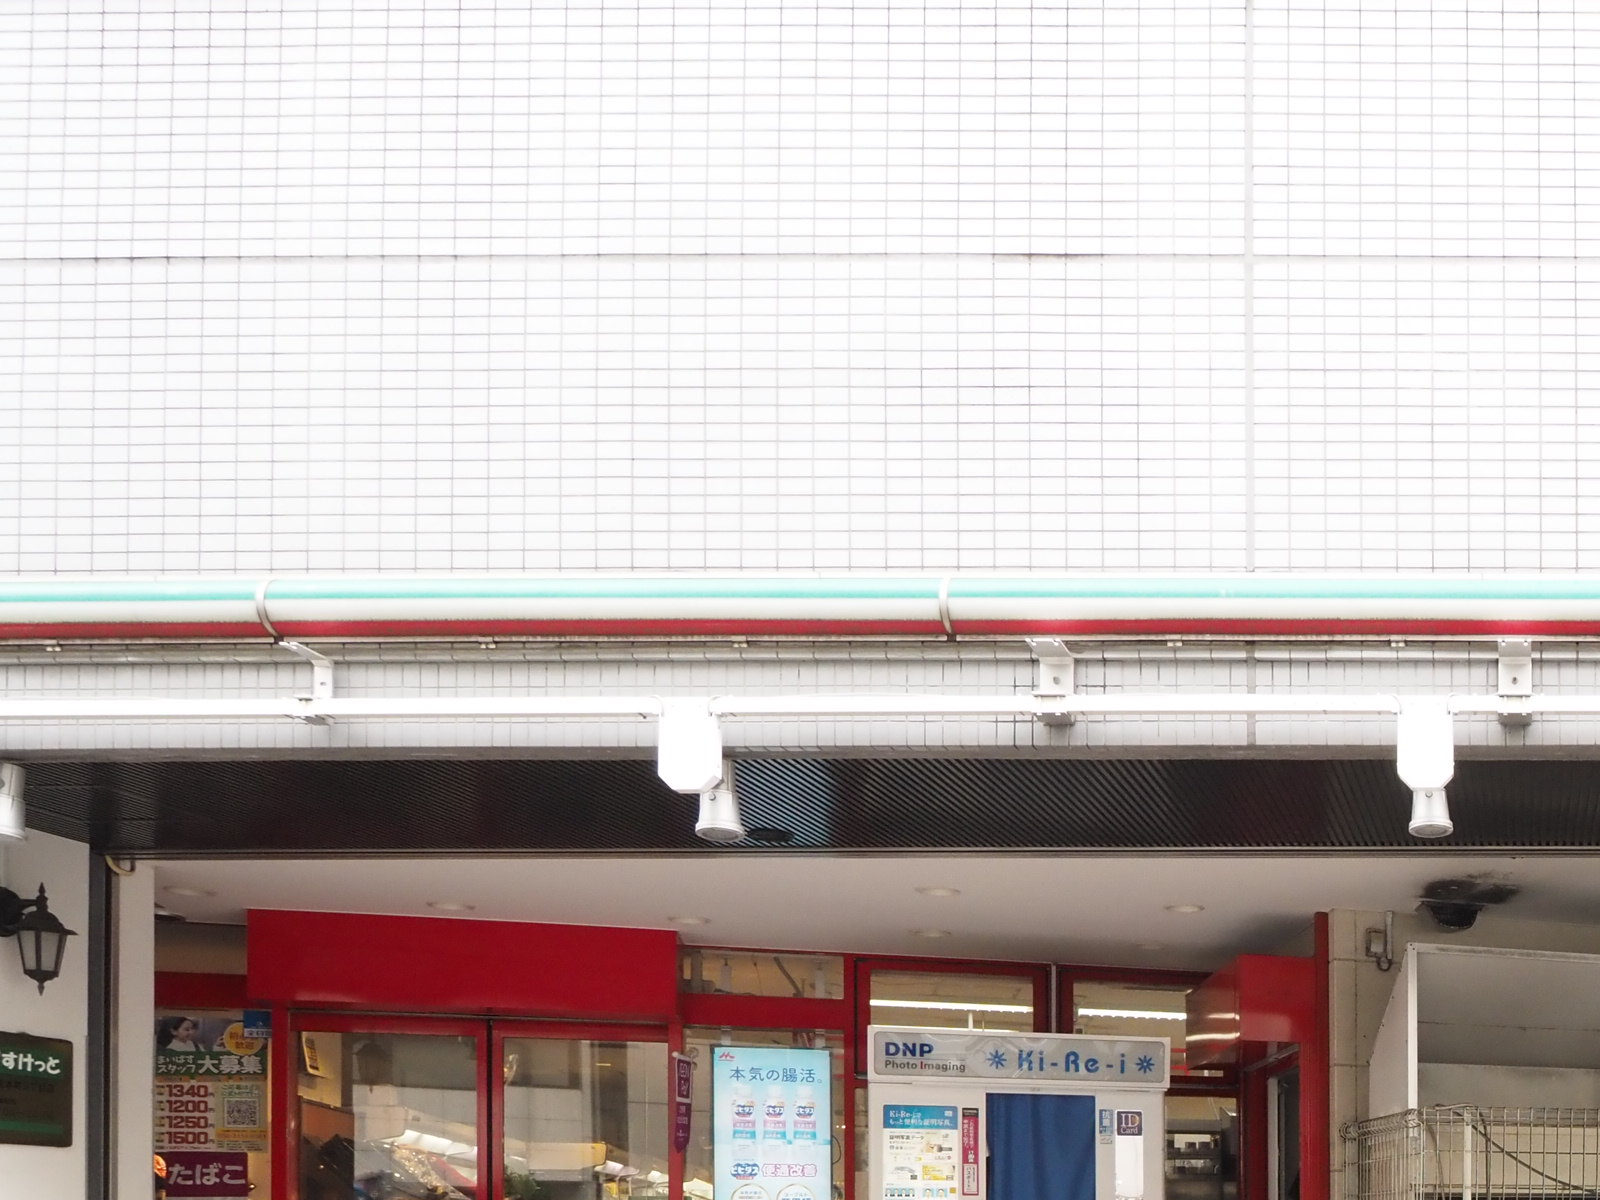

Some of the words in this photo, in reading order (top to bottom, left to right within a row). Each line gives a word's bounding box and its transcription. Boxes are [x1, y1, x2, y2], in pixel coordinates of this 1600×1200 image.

[884, 1041, 934, 1057] DNP
[0, 1051, 61, 1075] すけっと
[198, 1055, 262, 1074] 大募集
[884, 1060, 918, 1069] Photo
[920, 1060, 966, 1073] Imaging
[1017, 1049, 1126, 1074] Ki-Re-i
[729, 1066, 823, 1083] 本気の腸活。
[1120, 1113, 1140, 1127] ID
[168, 1162, 246, 1185] たばこ
[762, 1163, 817, 1177] 便通改善
